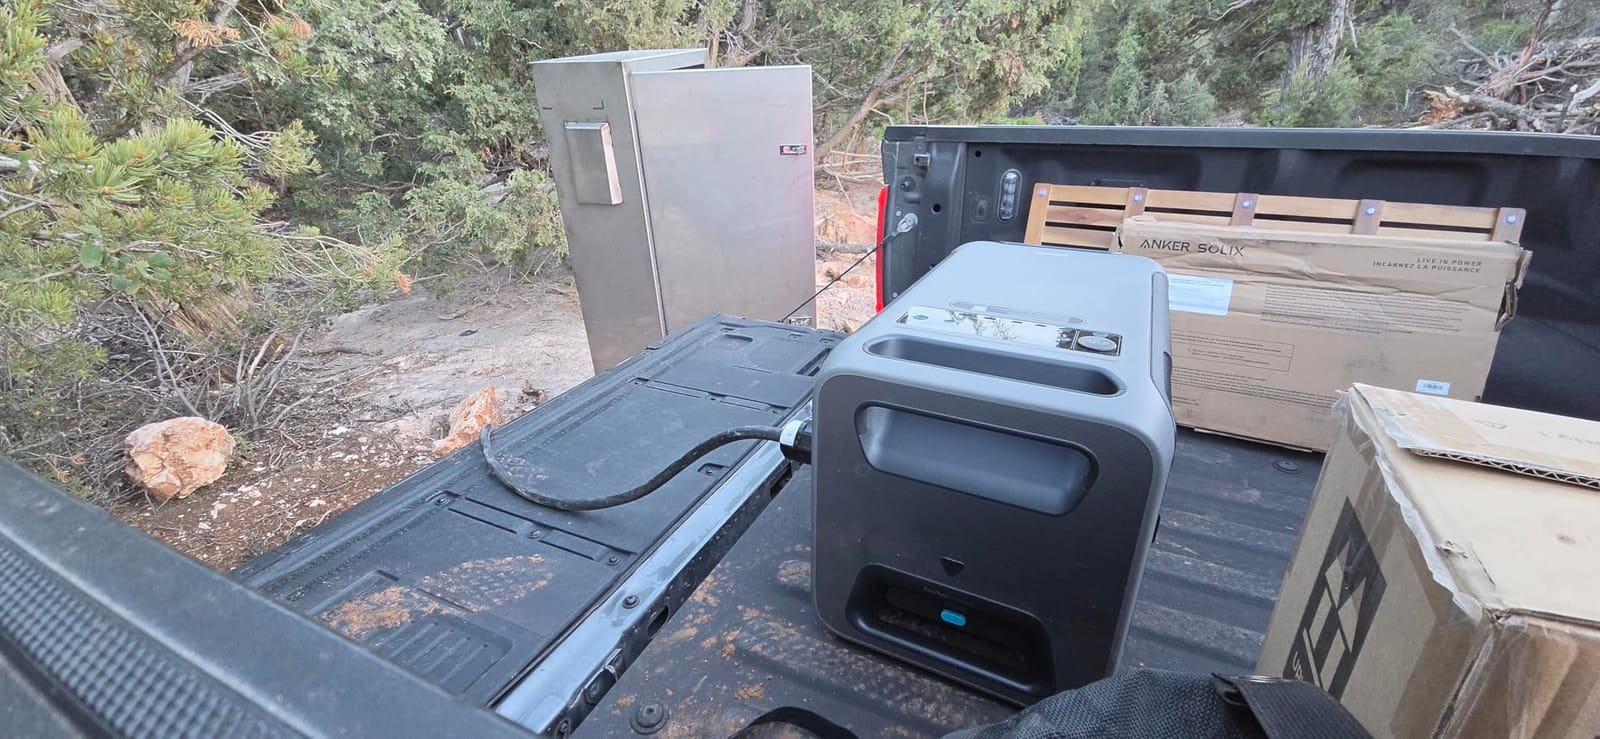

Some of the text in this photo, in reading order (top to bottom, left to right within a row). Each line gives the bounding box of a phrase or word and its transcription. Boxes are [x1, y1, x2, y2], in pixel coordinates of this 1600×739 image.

[1140, 239, 1244, 257] ANKER SOLIX
[1373, 261, 1415, 269] INCARNEZ
[1432, 264, 1481, 273] PUISSANCE
